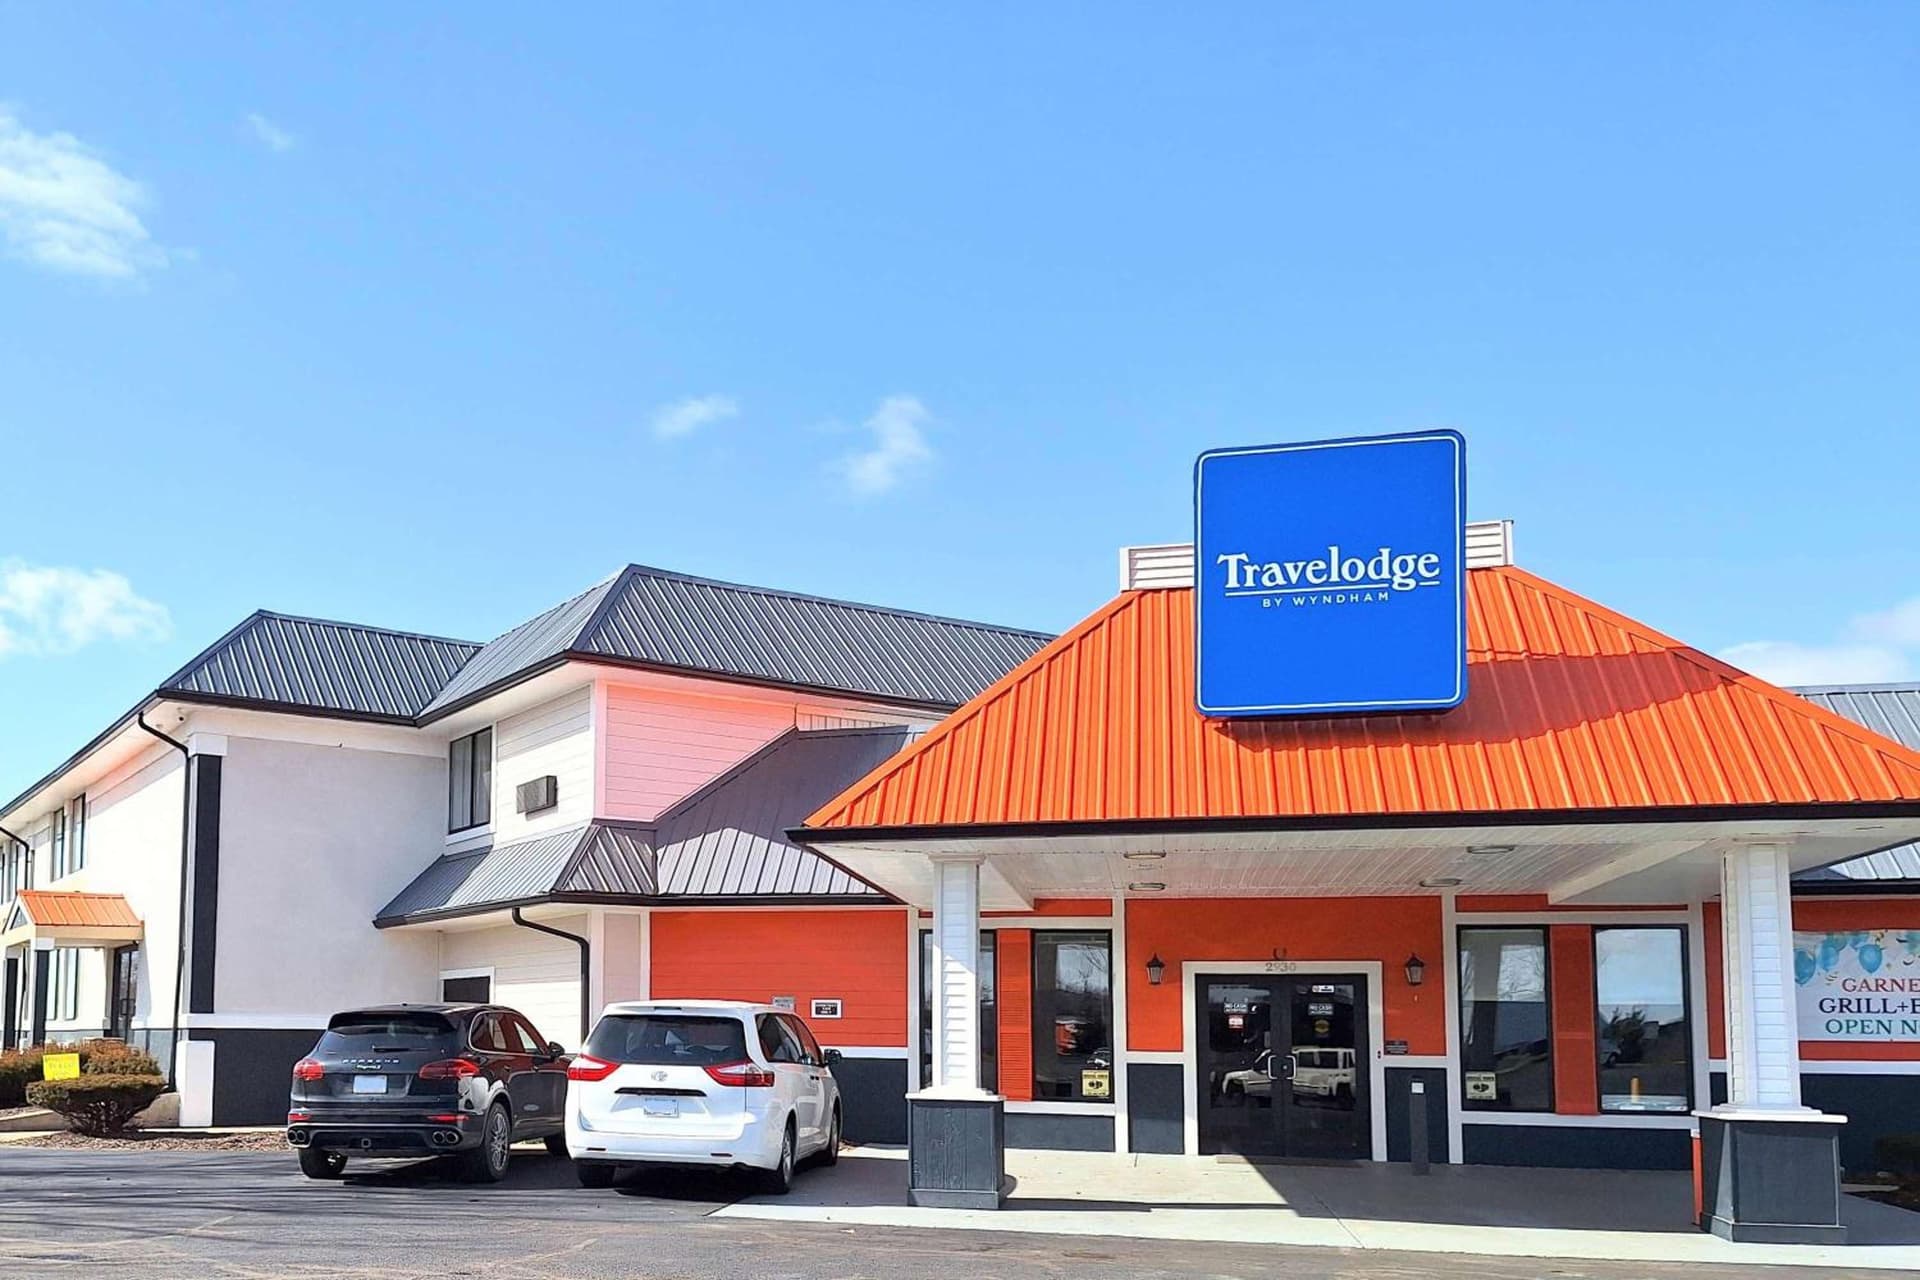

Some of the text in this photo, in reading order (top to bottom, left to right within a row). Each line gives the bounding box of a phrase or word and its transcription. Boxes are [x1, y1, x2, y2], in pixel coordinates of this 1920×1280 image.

[1216, 546, 1440, 591] Travelodge
[1262, 591, 1389, 608] BY WYNDHAM
[1264, 962, 1297, 972] 2930
[1825, 1018, 1893, 1035] OPEN
